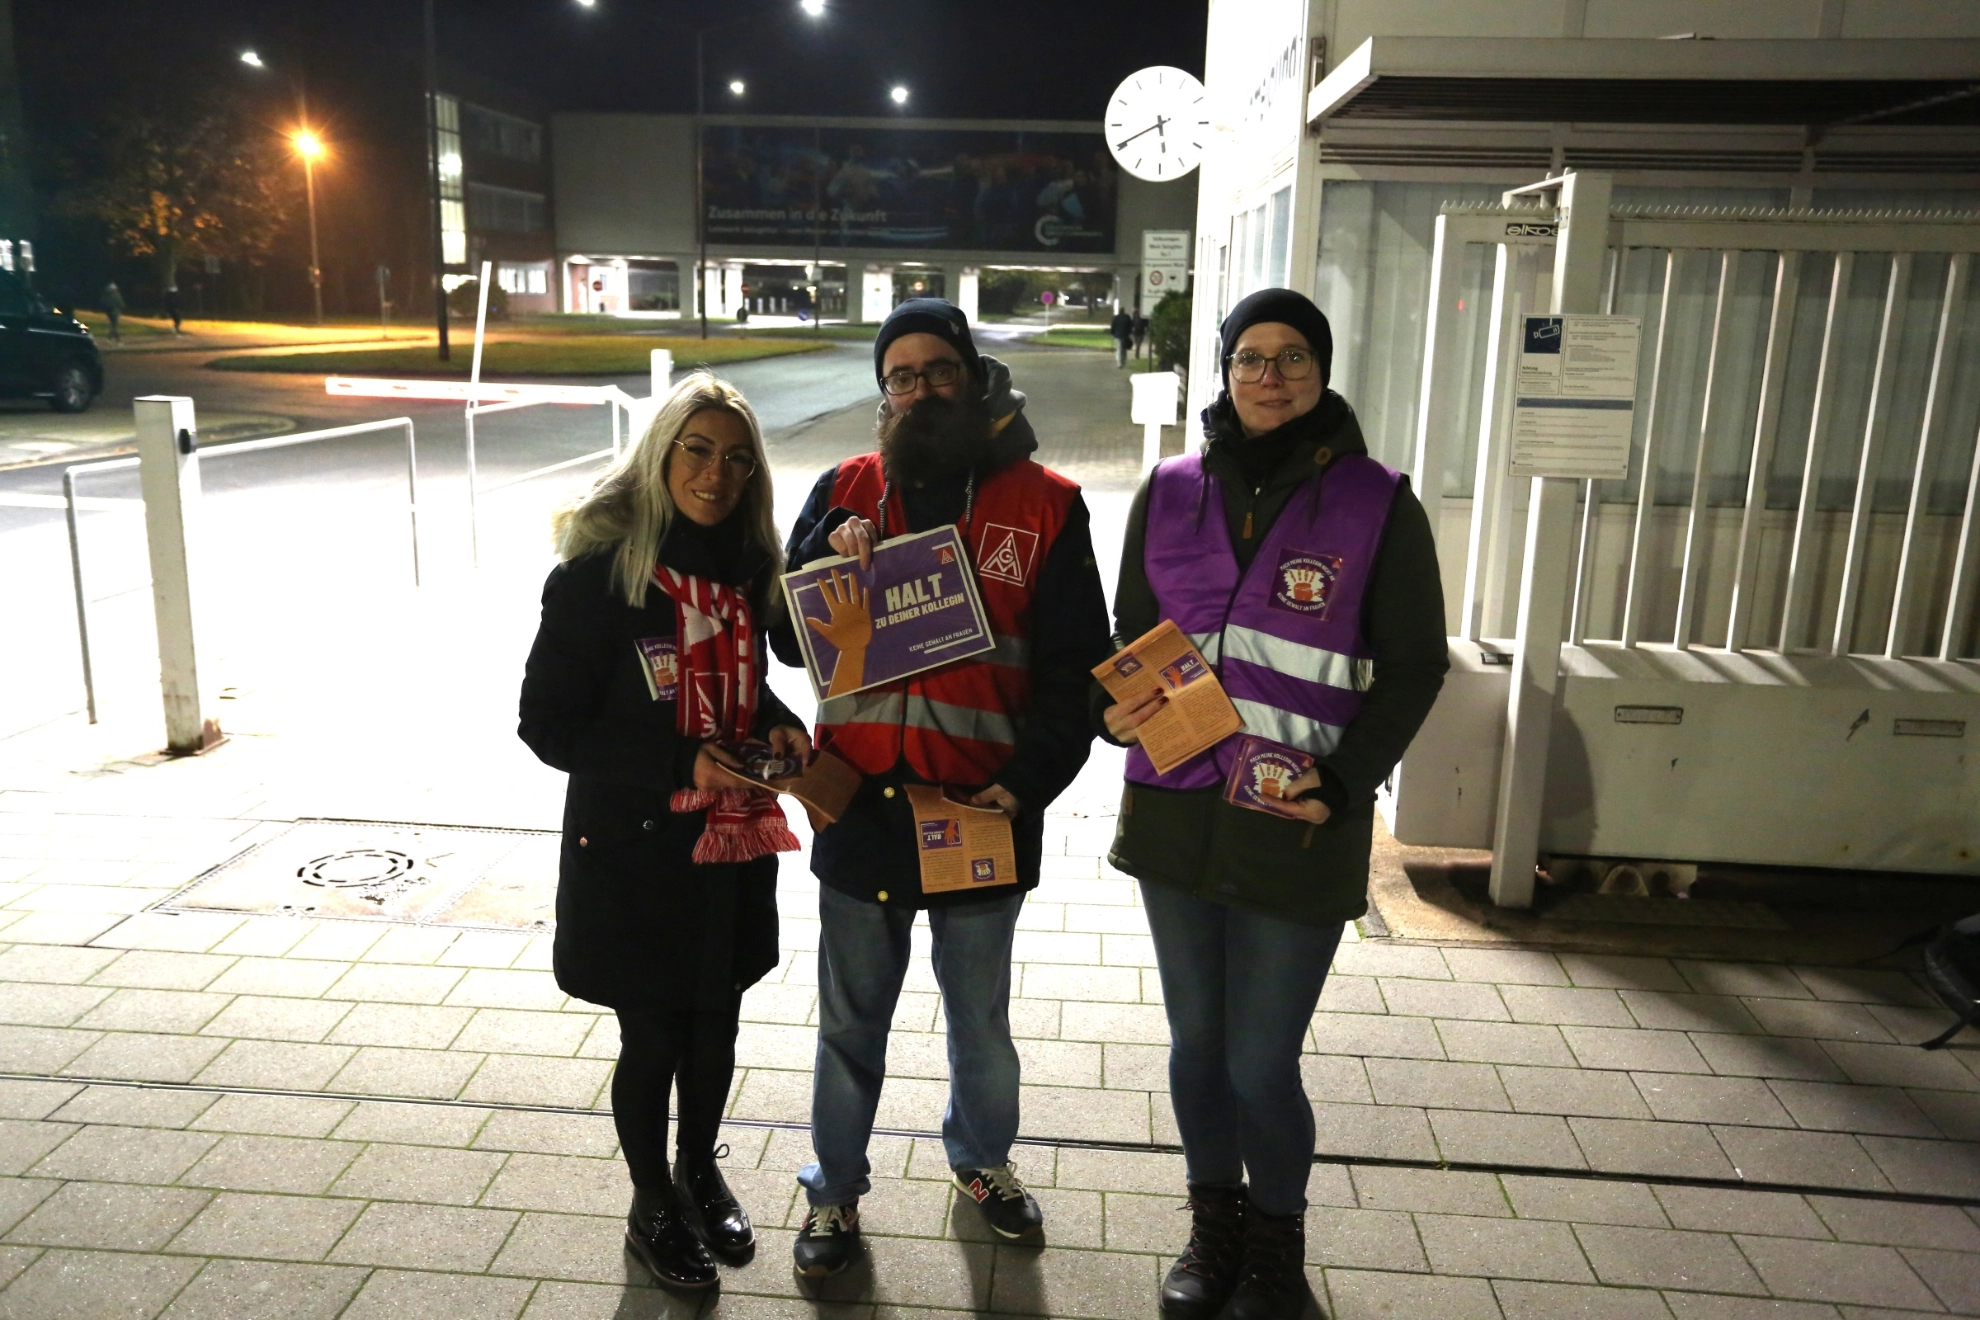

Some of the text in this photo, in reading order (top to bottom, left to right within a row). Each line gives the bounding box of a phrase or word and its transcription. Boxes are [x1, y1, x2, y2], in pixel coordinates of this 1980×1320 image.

[885, 572, 942, 612] HALT
[875, 592, 965, 629] ZU DEINER KOLLEGIN
[908, 628, 973, 652] KEINE GEWALT AN FRAUEN
[968, 1177, 990, 1204] N
